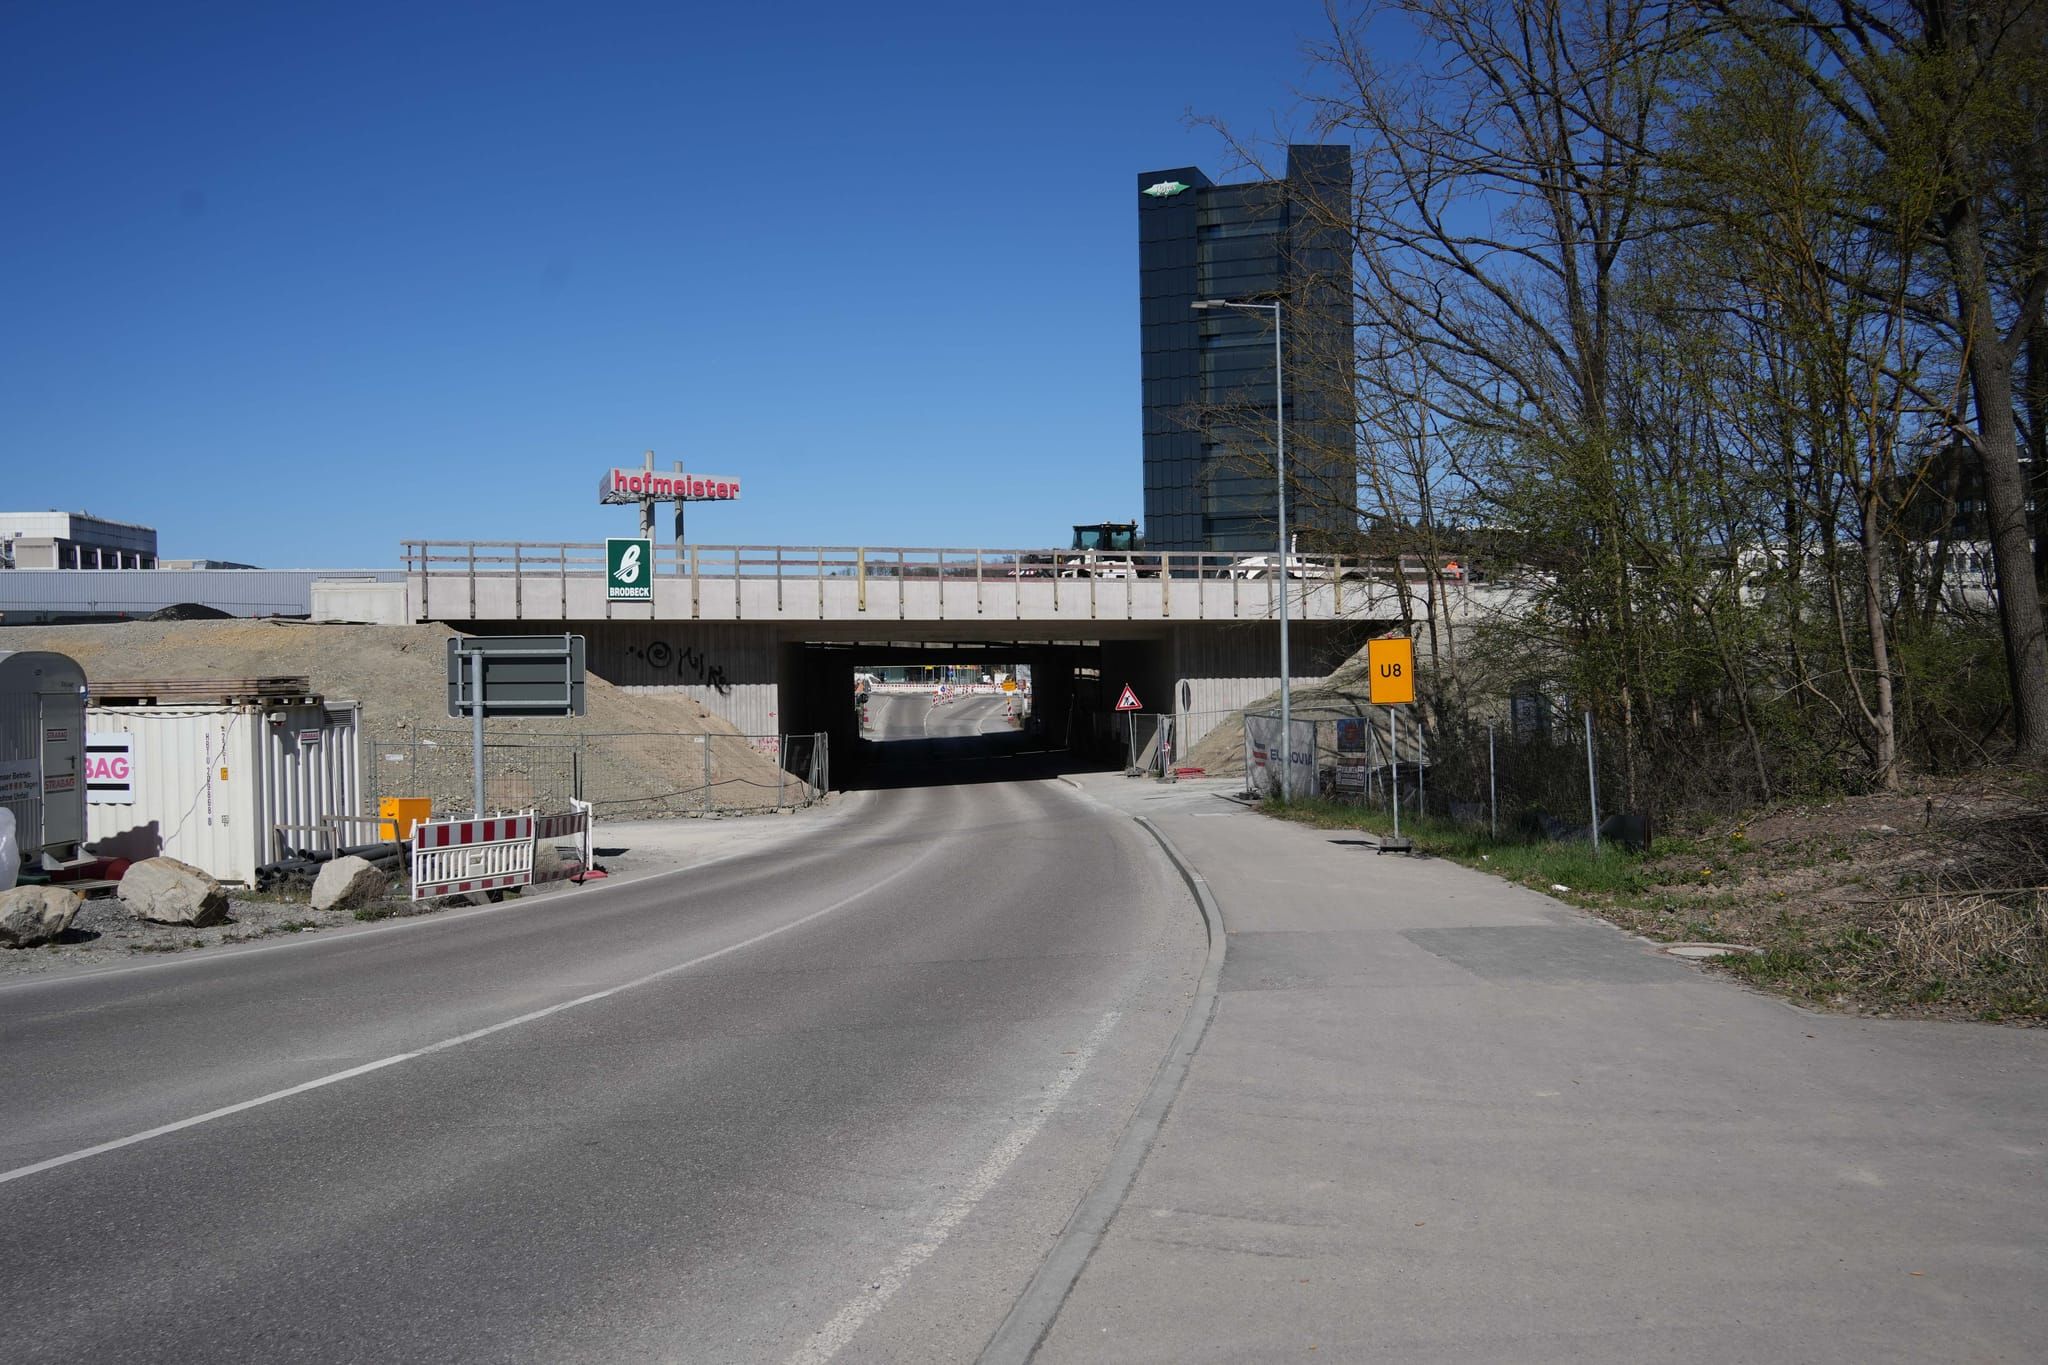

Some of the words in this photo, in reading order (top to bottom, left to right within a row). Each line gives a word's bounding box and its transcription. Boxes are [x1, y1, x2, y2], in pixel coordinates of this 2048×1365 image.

[614, 469, 740, 499] hofmeister
[609, 587, 650, 597] BRODBECK
[1381, 663, 1402, 678] U8
[1270, 749, 1313, 766] EUOVIA
[85, 757, 130, 779] BAG
[45, 778, 75, 790] STRABAG
